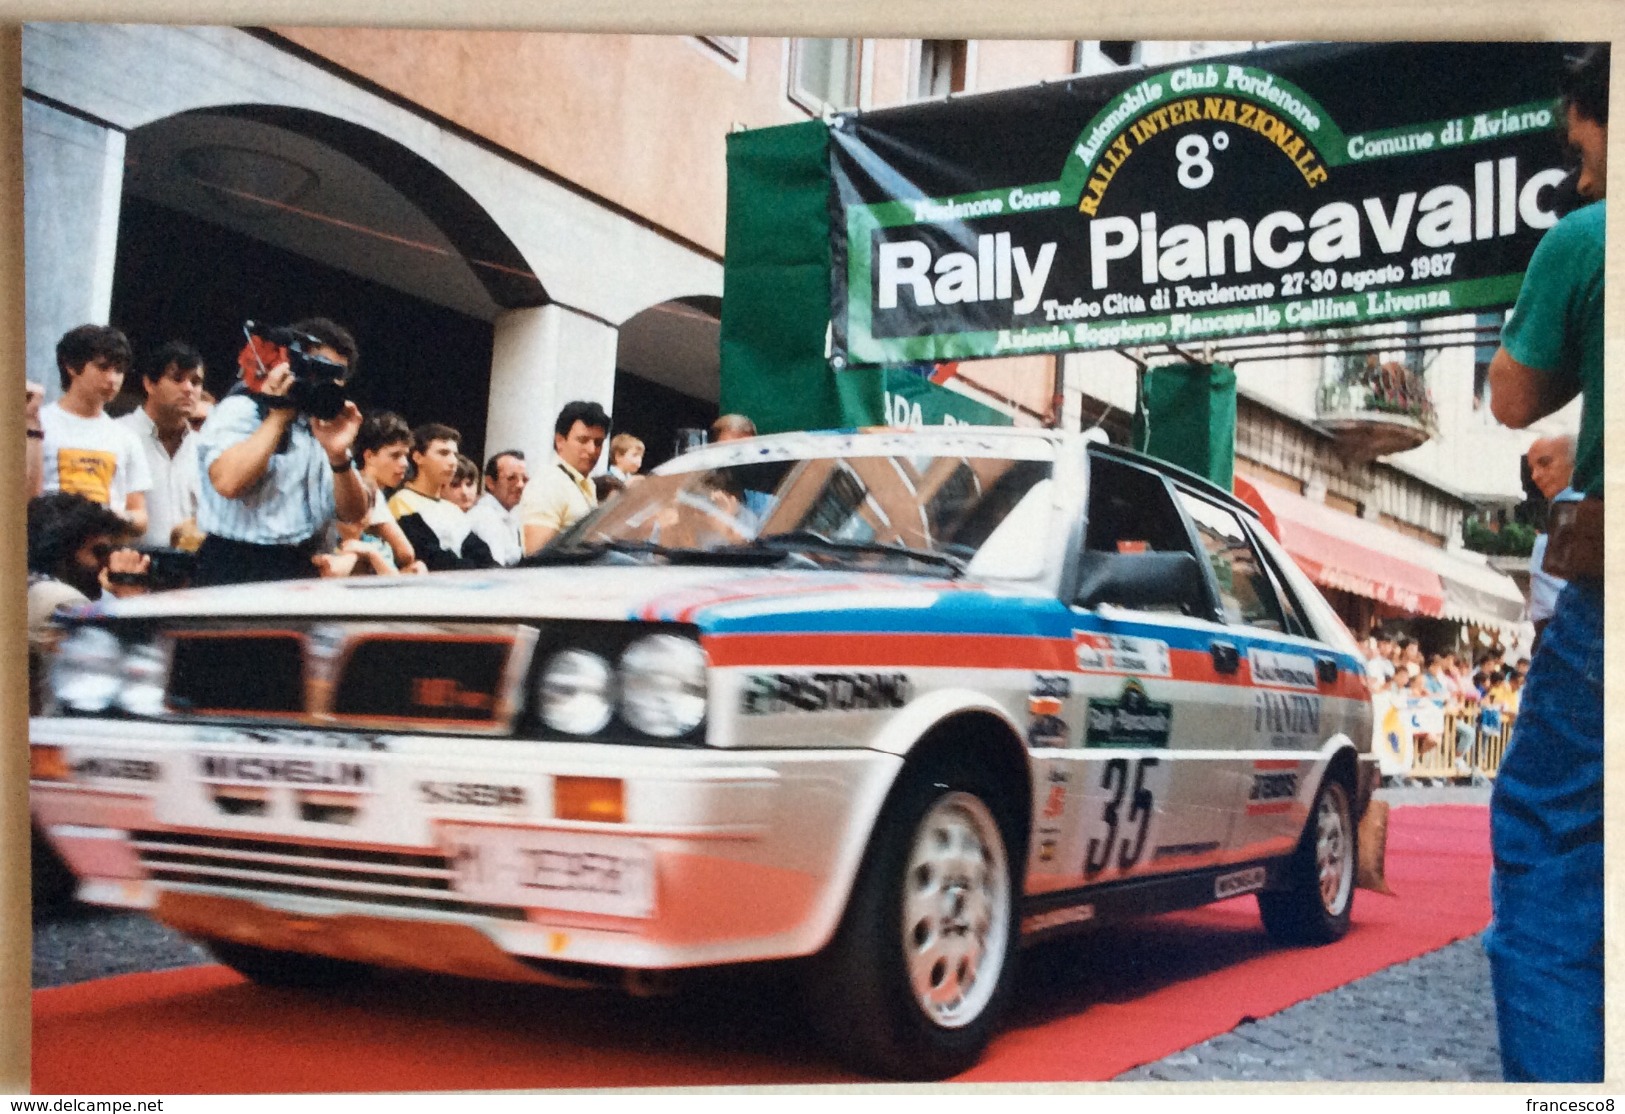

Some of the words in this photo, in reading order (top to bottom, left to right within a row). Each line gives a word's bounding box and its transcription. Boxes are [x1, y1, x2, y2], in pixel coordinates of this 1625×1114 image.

[1075, 81, 1162, 168] Automobile
[1171, 65, 1218, 92] Club
[1224, 65, 1320, 132] Pordenone
[1347, 131, 1435, 160] Comune
[1440, 119, 1465, 146] di
[1469, 109, 1551, 140] Aviano
[914, 199, 1003, 222] Pordenone
[1008, 187, 1061, 211] Corse
[1079, 134, 1132, 217] RALLY
[879, 232, 1057, 315] Rally
[1043, 297, 1101, 321] Trofeo
[1150, 288, 1171, 310] di
[1175, 281, 1275, 309] Pordenone
[1341, 264, 1405, 292] agosto
[1411, 253, 1456, 280] 1987
[996, 324, 1070, 350] Azienda
[1073, 319, 1167, 346] Soggiorno
[1170, 304, 1281, 337] Piancavallo
[1367, 289, 1450, 316] Livenza
[1083, 757, 1160, 880] 35
